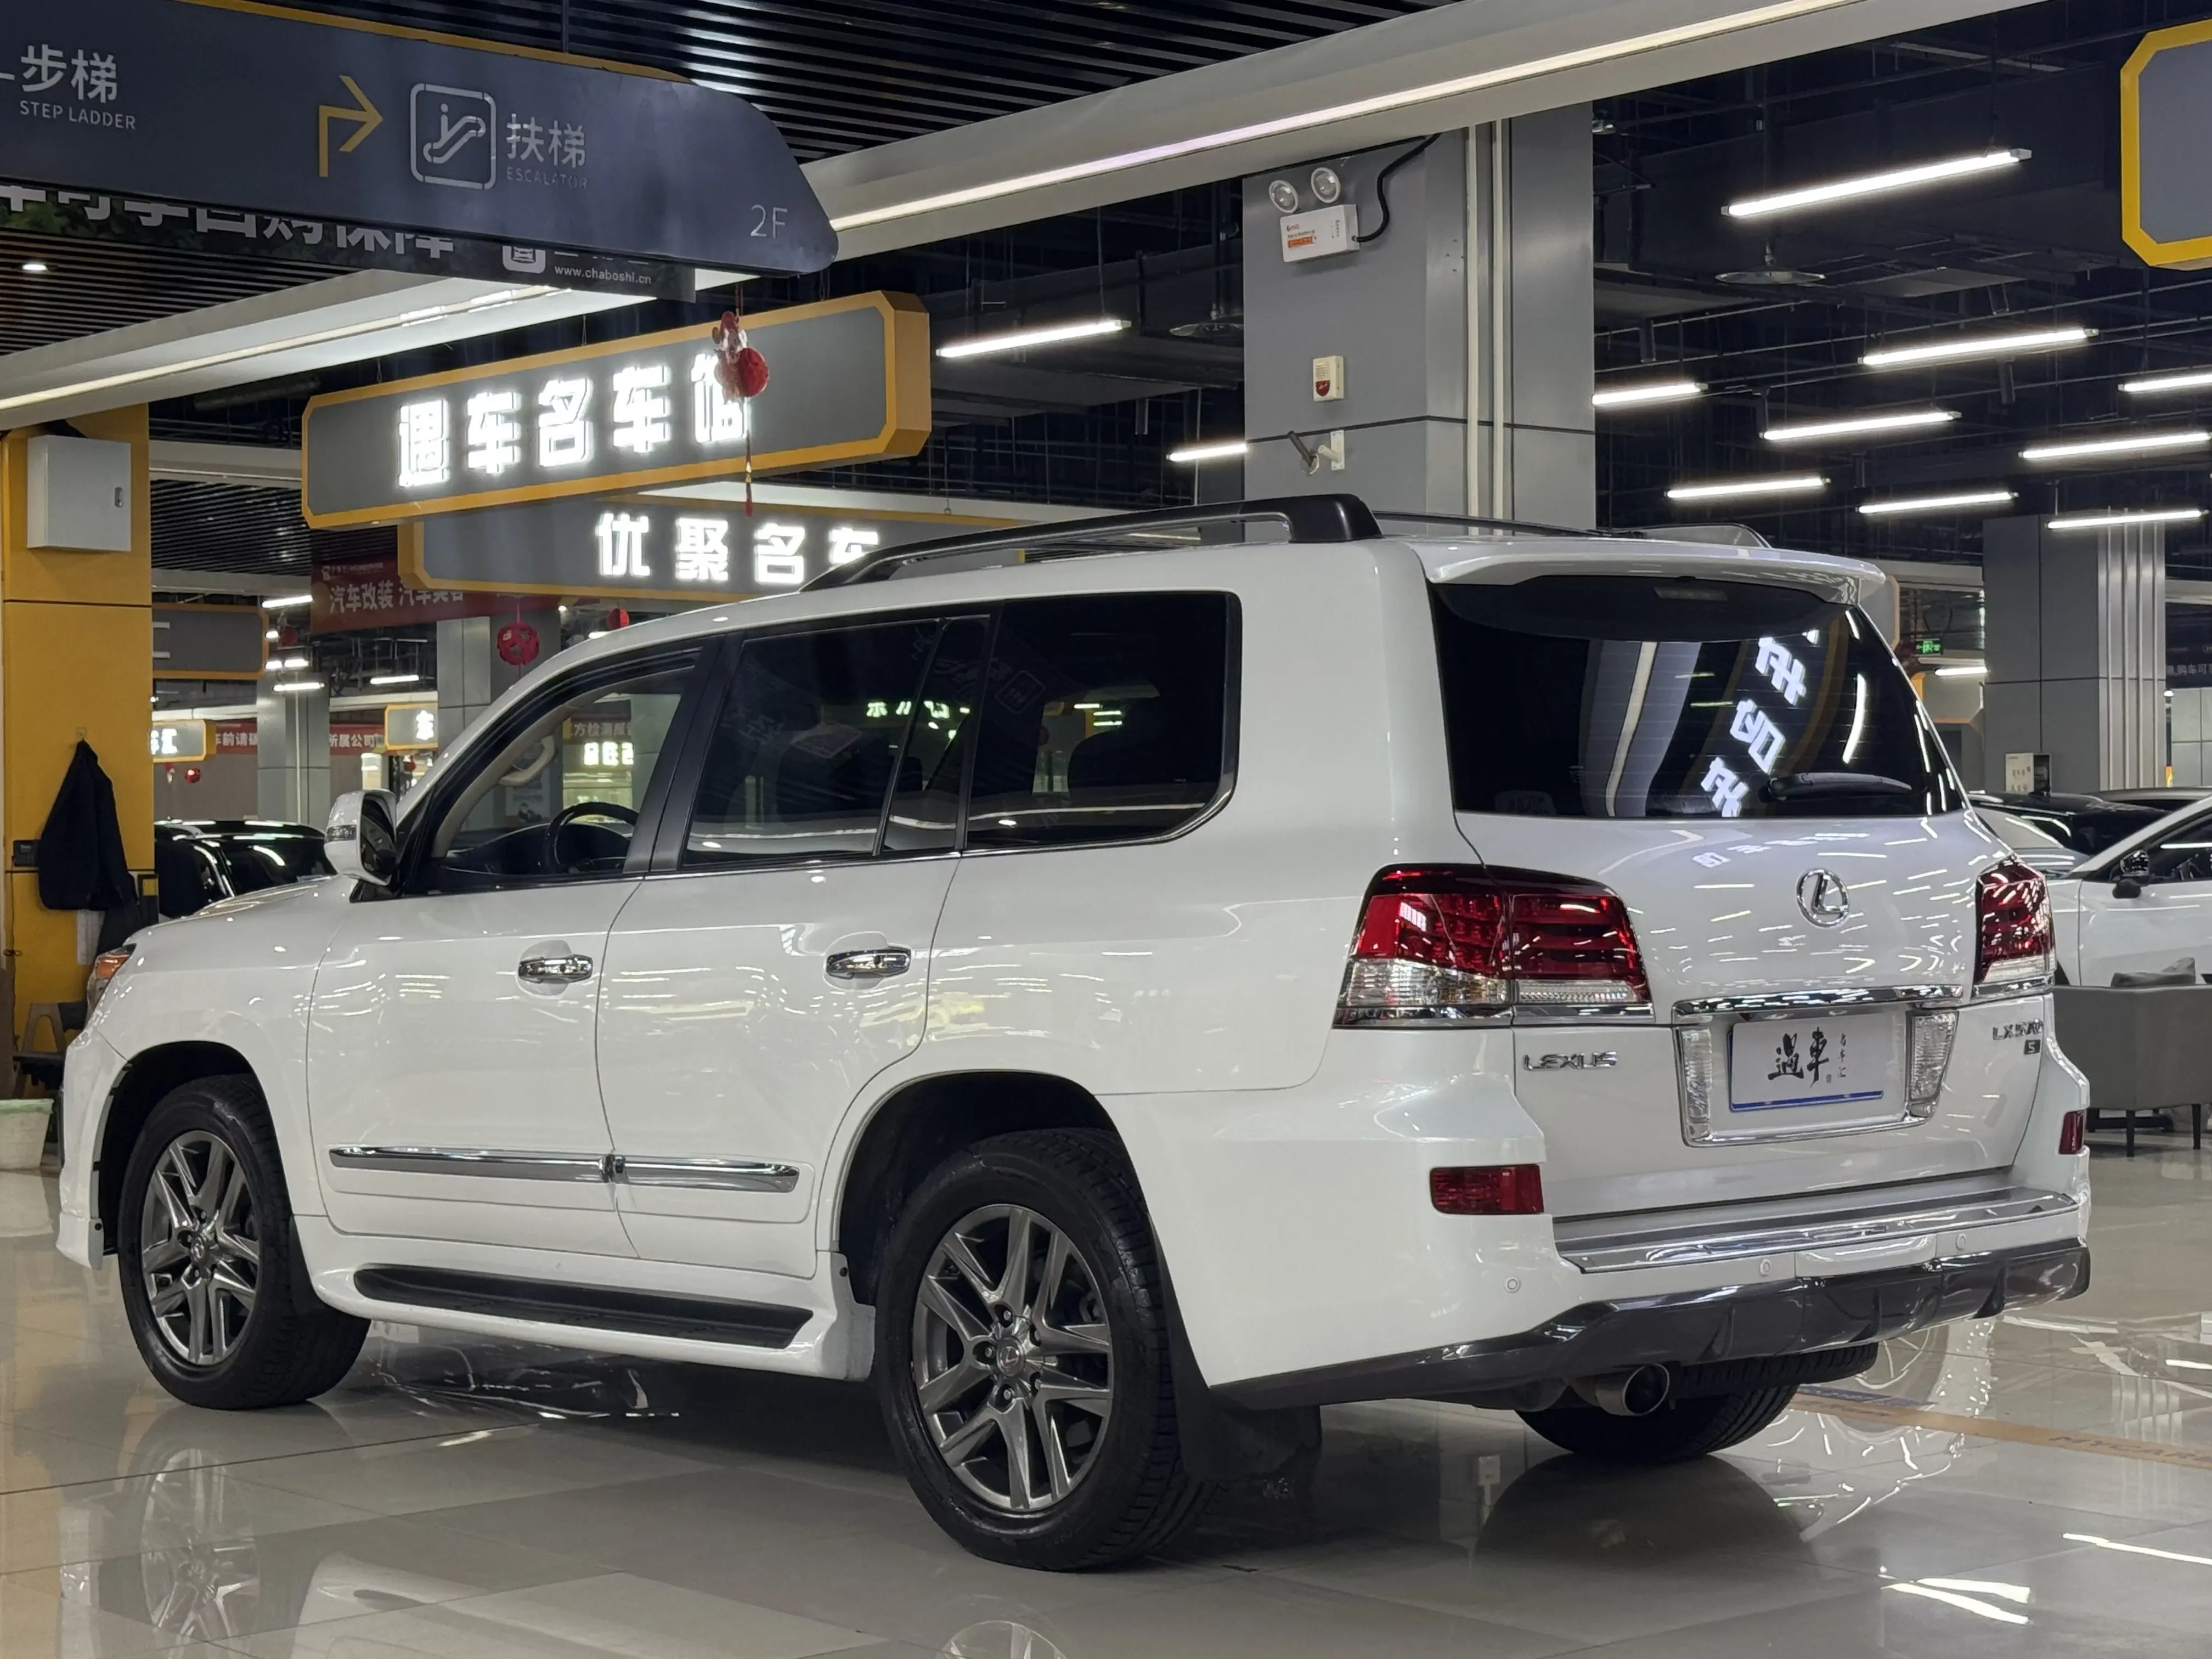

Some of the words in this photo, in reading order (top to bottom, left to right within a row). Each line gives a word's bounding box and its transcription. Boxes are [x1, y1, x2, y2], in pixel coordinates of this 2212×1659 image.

[19, 99, 64, 119] STEP
[69, 106, 136, 130] LADDER
[506, 112, 586, 168] 扶梯
[506, 166, 588, 189] ESCALATOR
[750, 204, 788, 239] 2F
[554, 264, 652, 285] www.chaboshi.cn
[330, 579, 394, 614] 汽车改装
[1523, 1051, 1618, 1071] LEXUS
